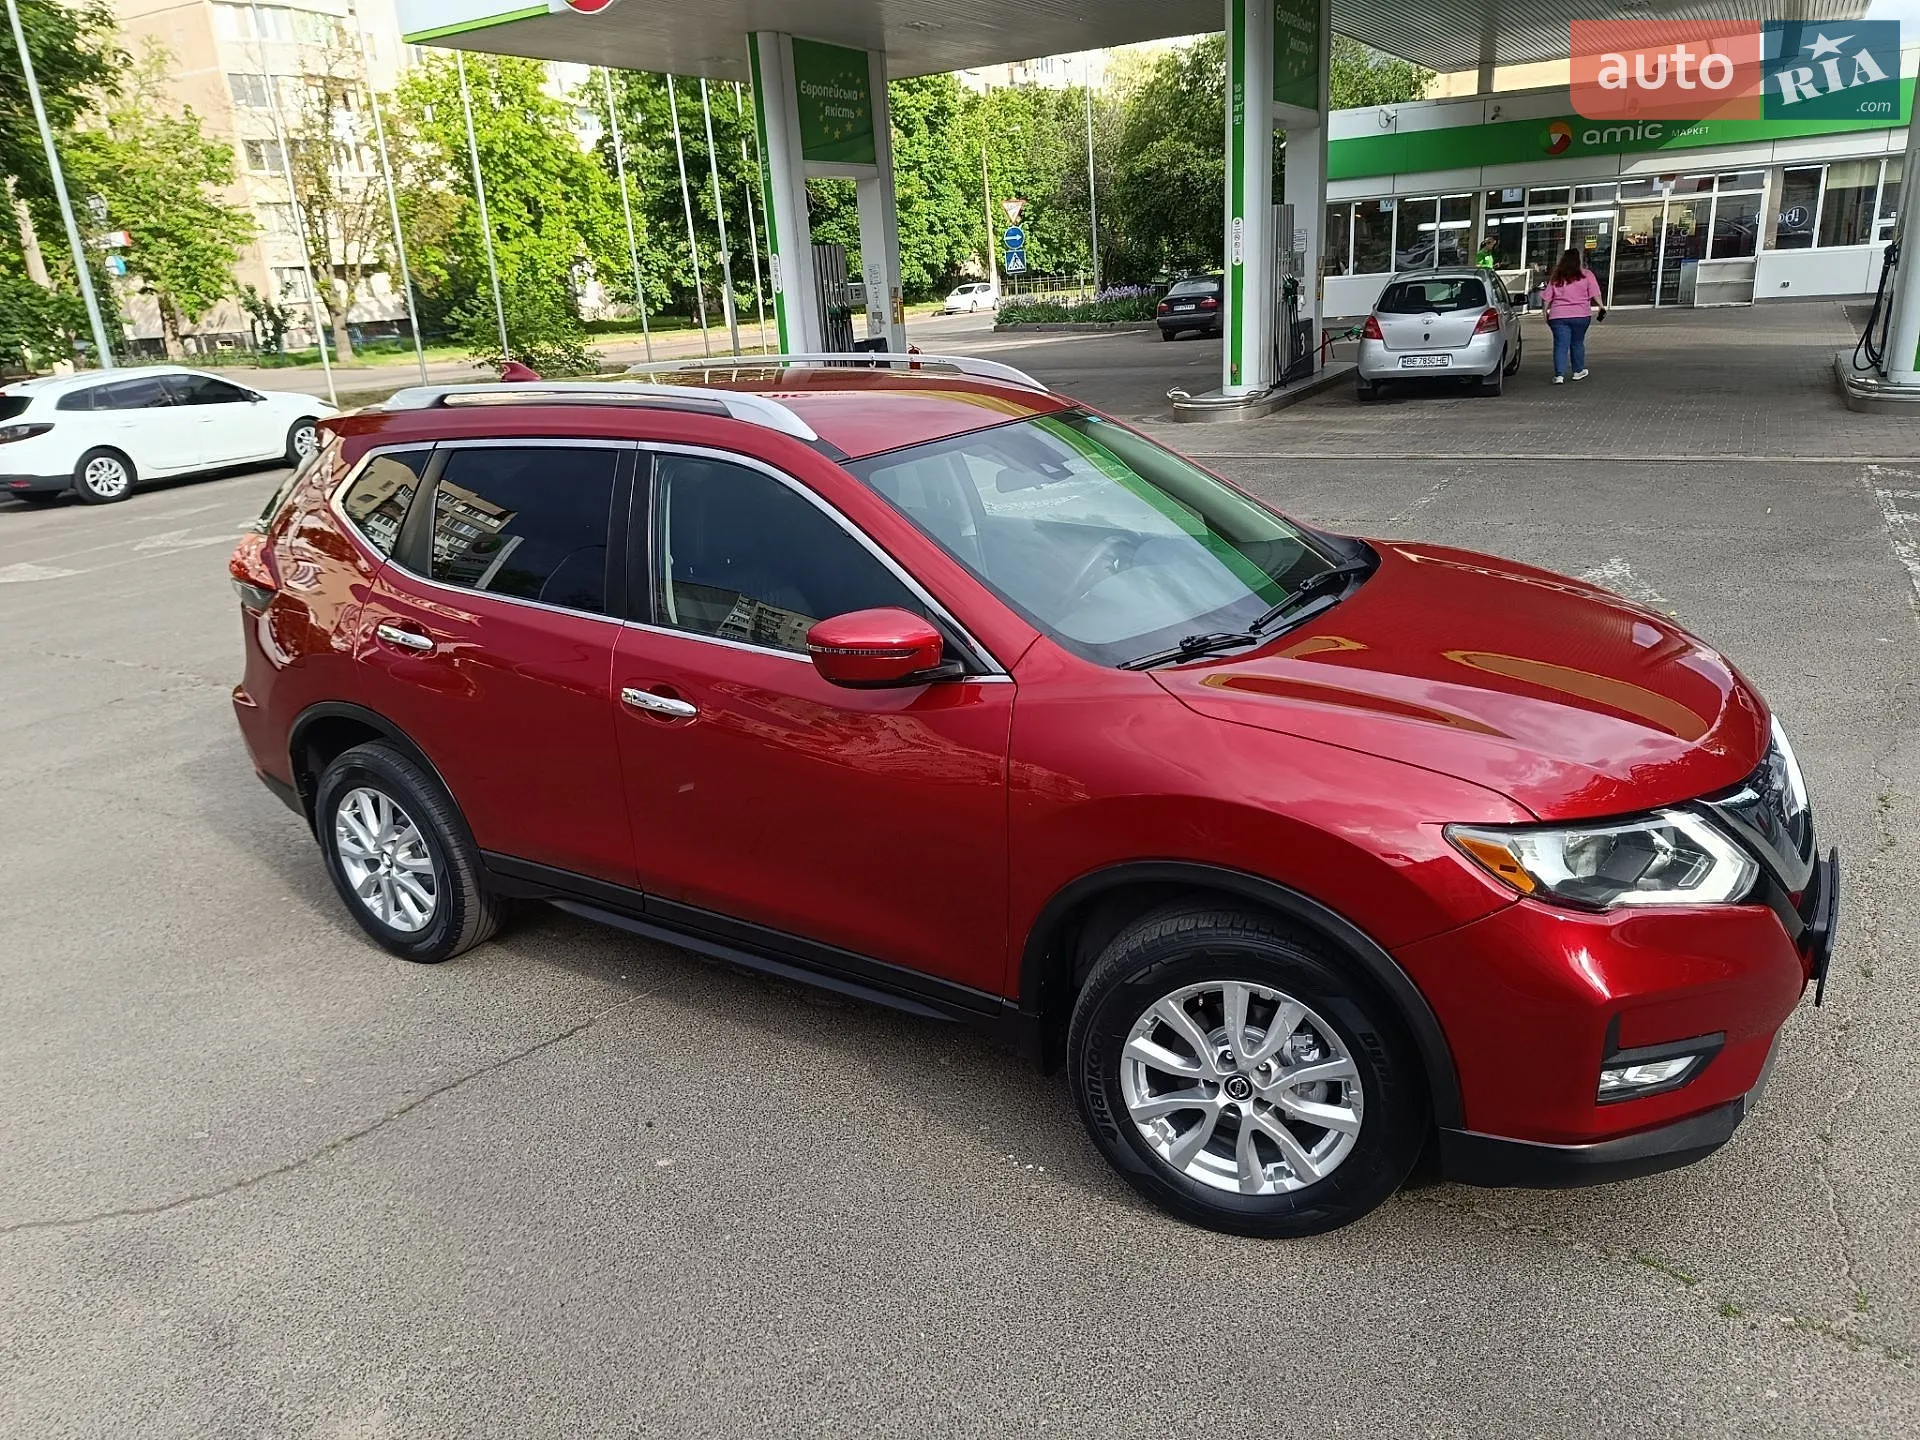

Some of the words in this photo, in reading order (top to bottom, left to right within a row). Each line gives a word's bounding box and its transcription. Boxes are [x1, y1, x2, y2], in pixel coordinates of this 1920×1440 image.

[800, 80, 858, 101] Європейська
[824, 103, 855, 119] якість
[1582, 120, 1663, 145] amic
[1671, 127, 1710, 137] МАРКЕТ
